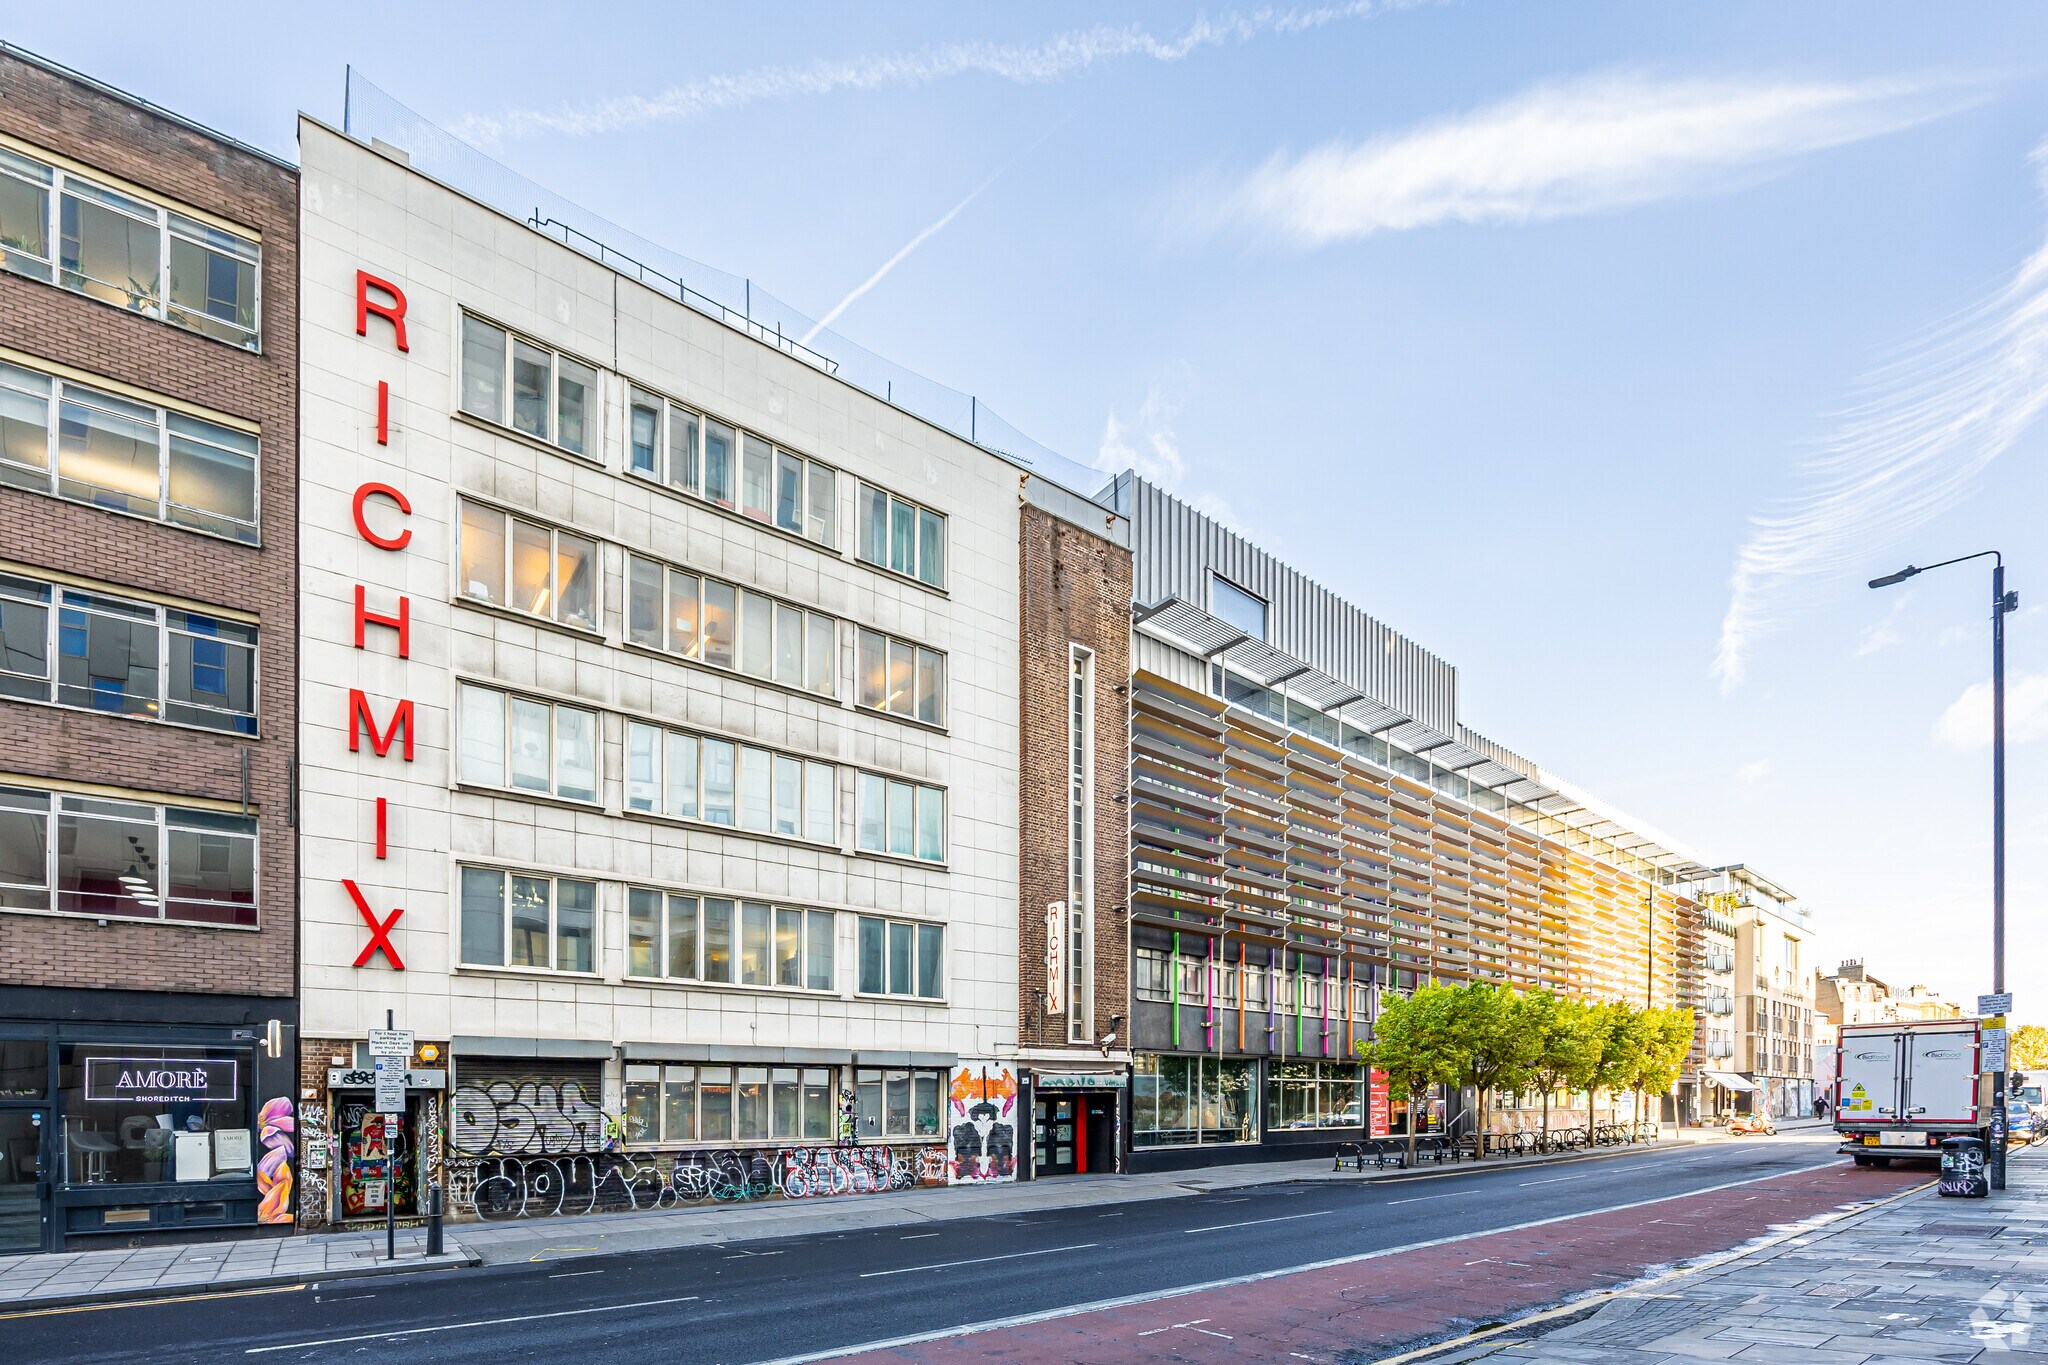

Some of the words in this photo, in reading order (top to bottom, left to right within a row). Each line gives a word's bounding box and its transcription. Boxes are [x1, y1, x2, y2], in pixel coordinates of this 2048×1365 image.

[341, 268, 414, 972] RICHMIX
[1049, 906, 1059, 1010] RICHMIX
[115, 1068, 208, 1089] AMORÈ
